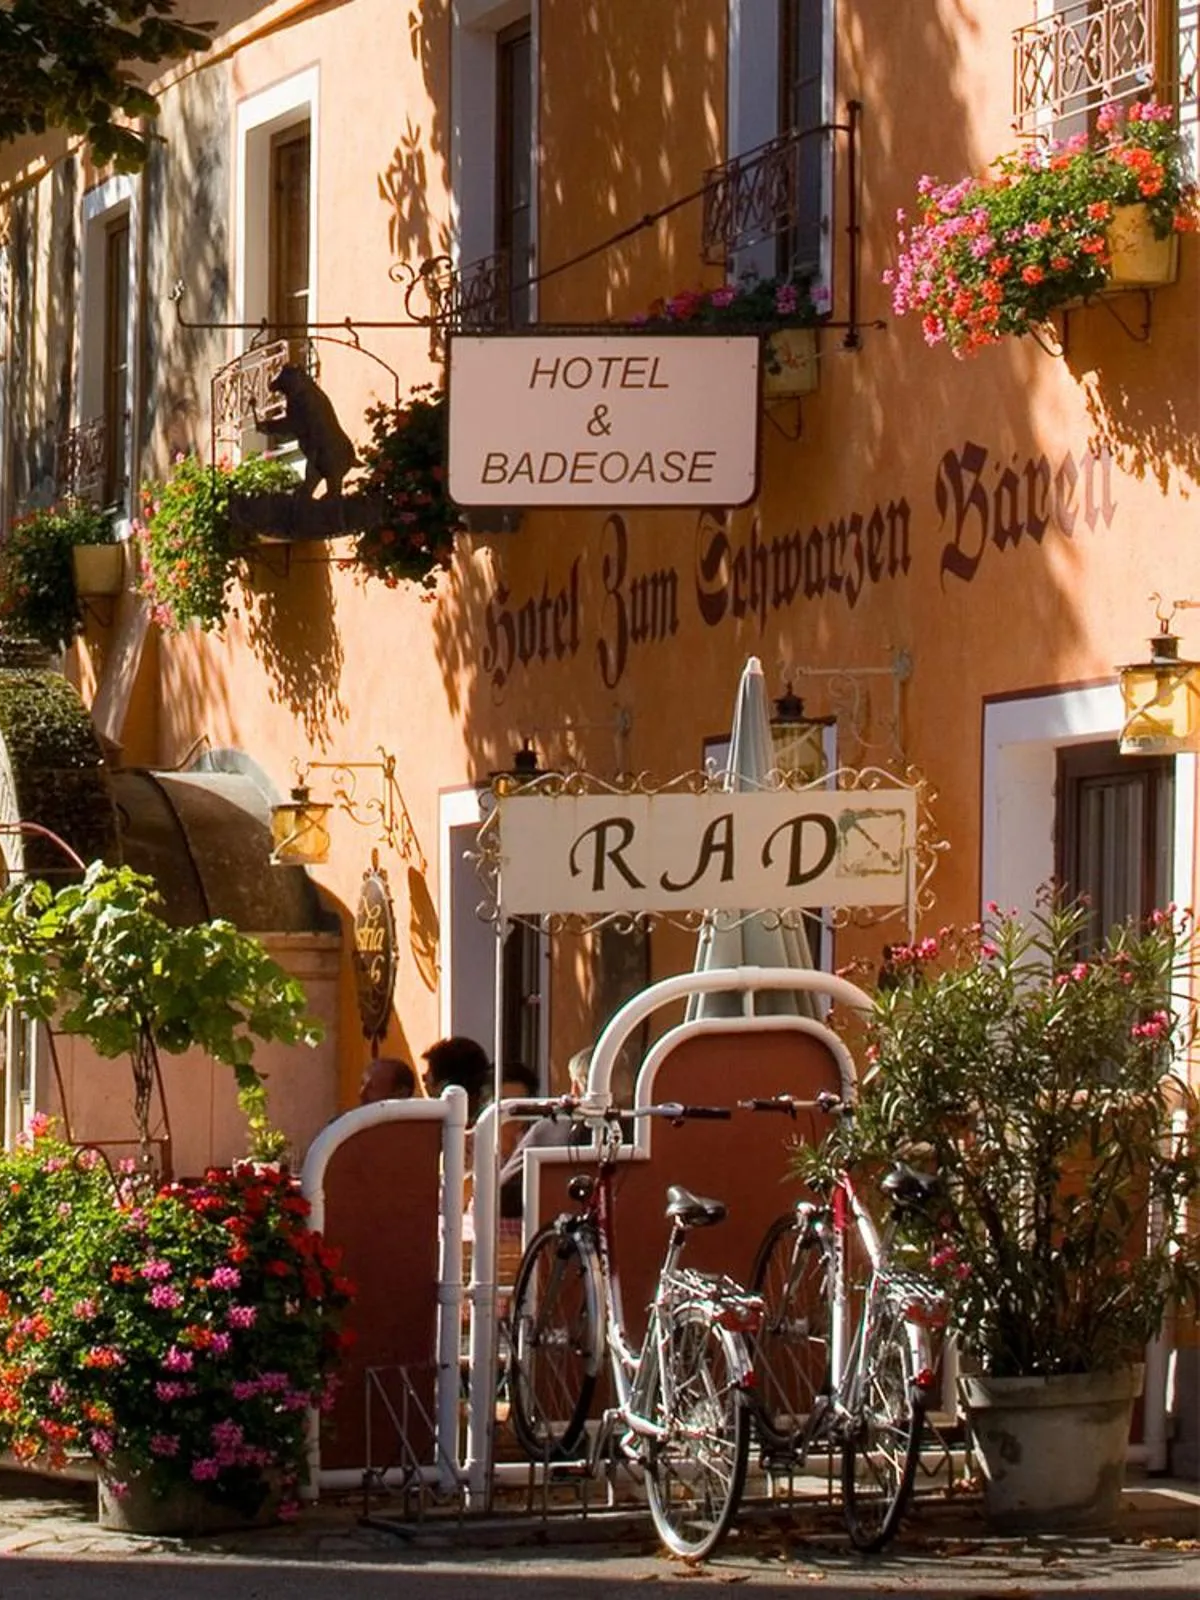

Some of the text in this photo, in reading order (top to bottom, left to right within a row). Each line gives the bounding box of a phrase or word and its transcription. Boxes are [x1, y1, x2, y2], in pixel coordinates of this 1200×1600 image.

[529, 356, 669, 389] HOTEL
[586, 403, 612, 437] &
[481, 450, 717, 485] BADEOASE
[482, 440, 1119, 690] Hotel Zum Schwarzen Bären
